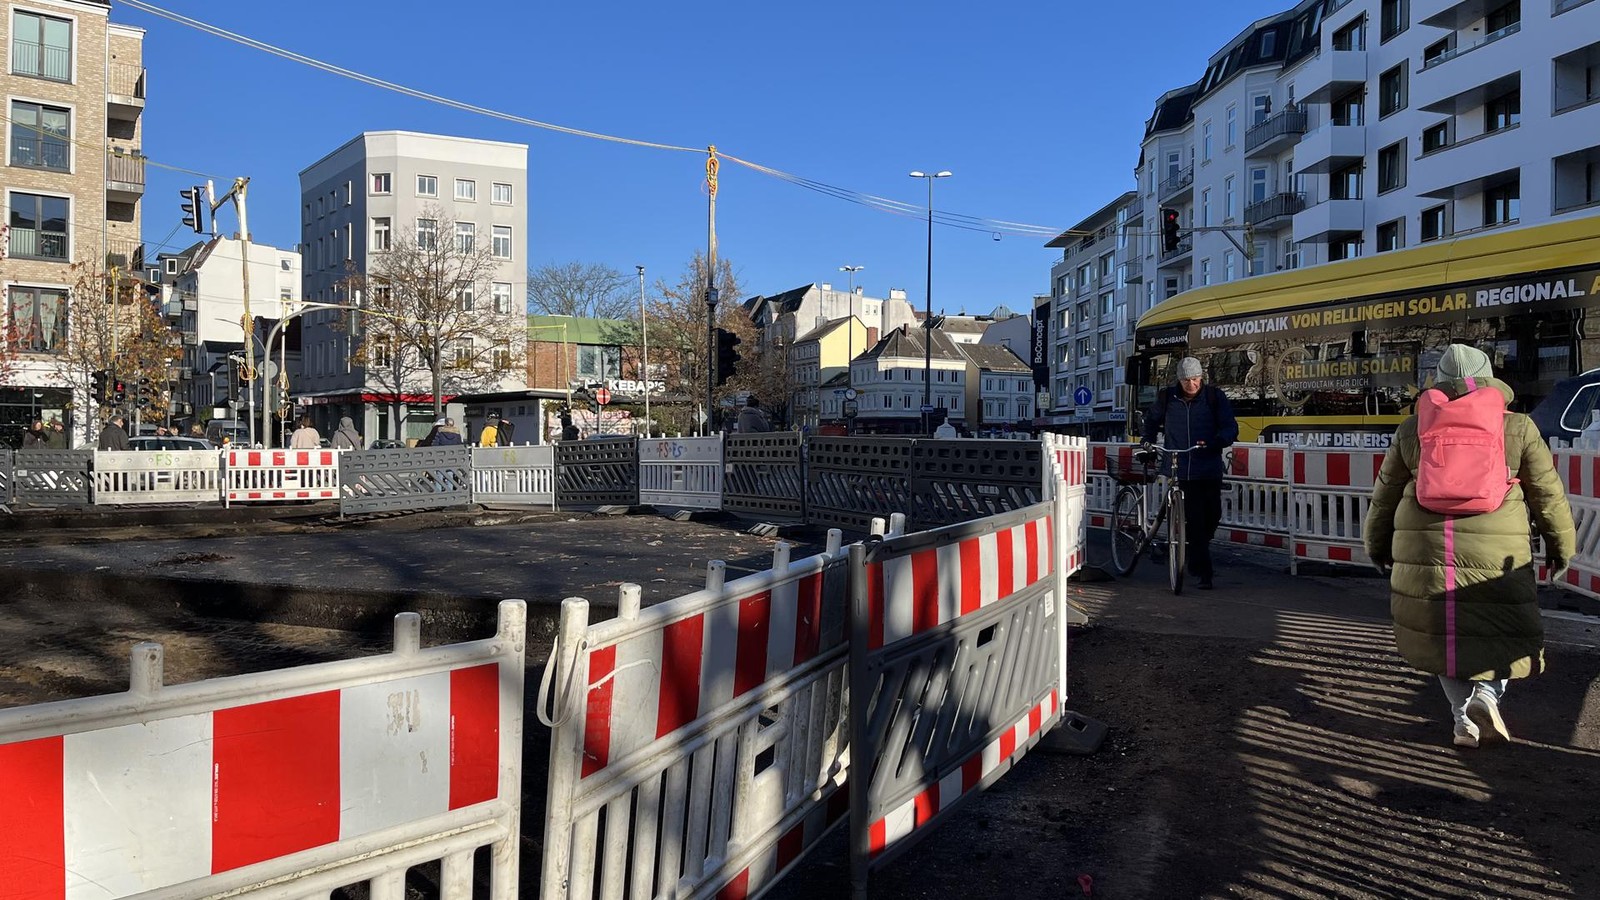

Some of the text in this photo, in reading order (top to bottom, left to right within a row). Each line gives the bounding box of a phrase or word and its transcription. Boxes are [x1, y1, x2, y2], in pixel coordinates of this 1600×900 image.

[1201, 316, 1288, 340] PHOTOVOLTAIK
[1291, 312, 1321, 329] VON
[1323, 300, 1404, 326] RELLINGEN
[1408, 292, 1472, 316] SOLAR.
[1476, 279, 1585, 308] REGIONAL.
[1035, 320, 1044, 363] BoConcept
[1156, 335, 1186, 345] HOCHBAHN
[1286, 356, 1412, 380] RELLINGEN SOLAR
[609, 380, 666, 392] KEBAP'S
[1286, 378, 1369, 390] PHOTOVOLTAIK FÜR DICH
[1272, 432, 1304, 445] LIEBE
[1306, 432, 1331, 446] AUF
[1334, 433, 1360, 447] DEN
[155, 453, 172, 466] FS
